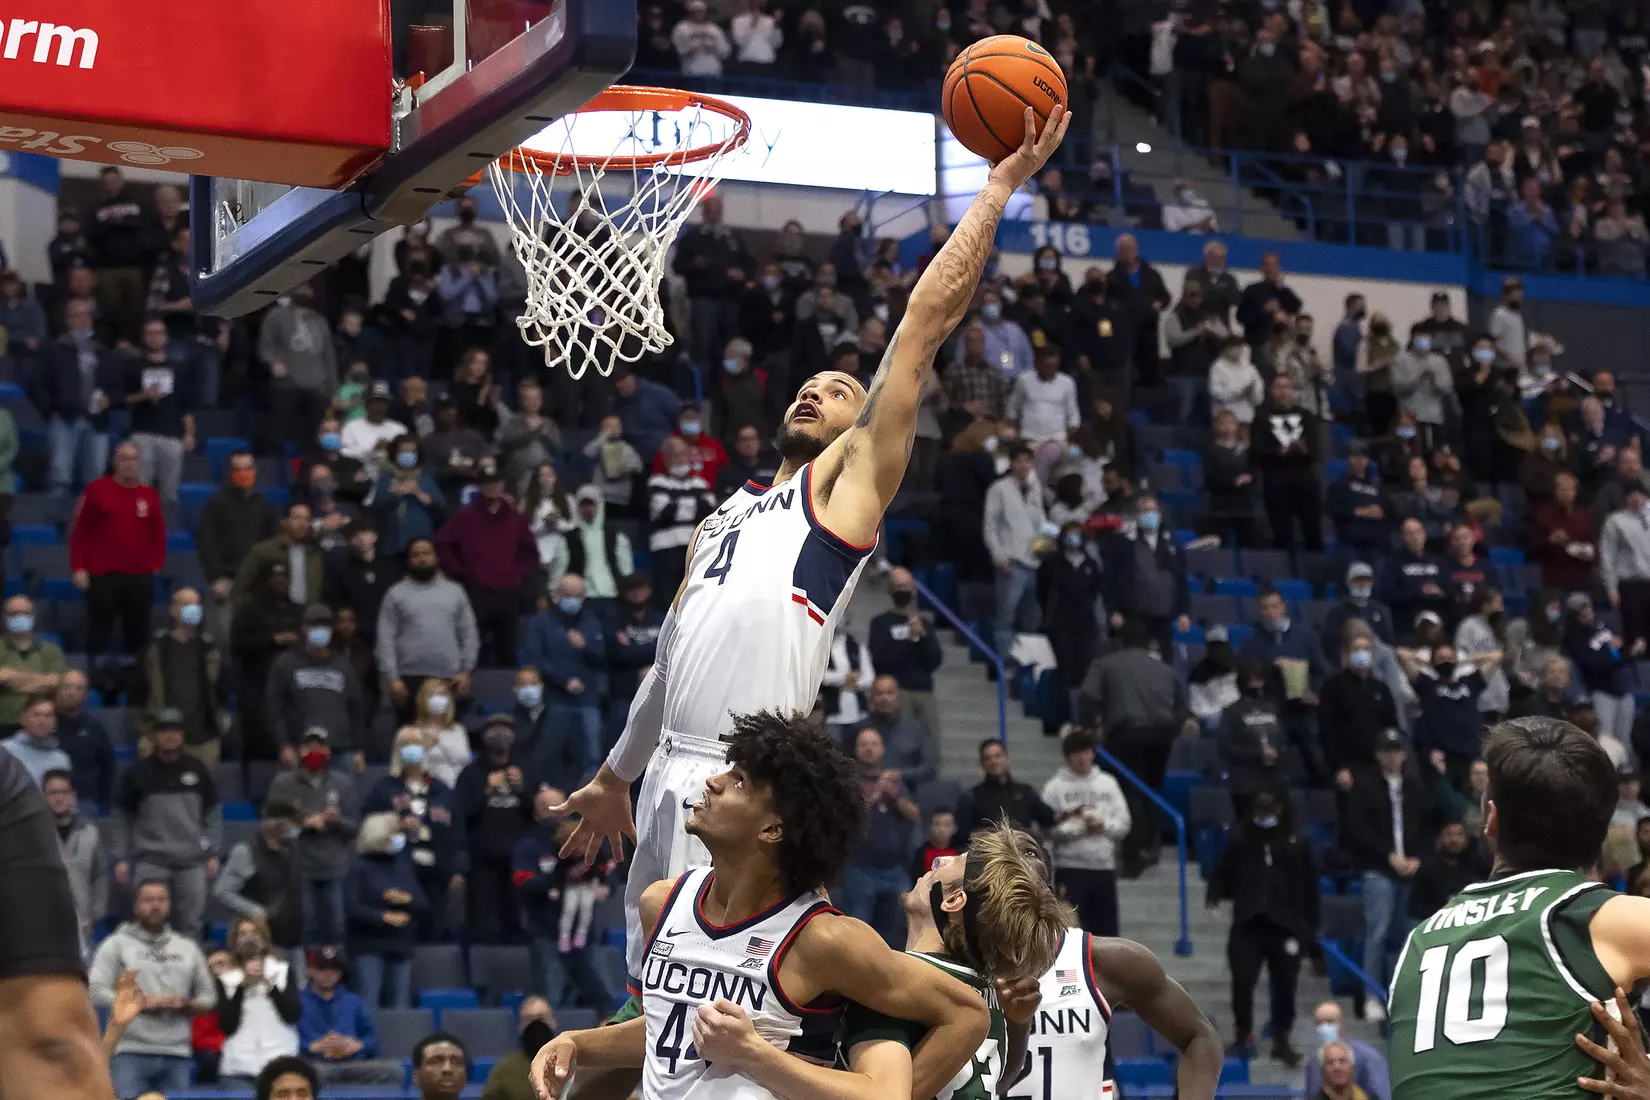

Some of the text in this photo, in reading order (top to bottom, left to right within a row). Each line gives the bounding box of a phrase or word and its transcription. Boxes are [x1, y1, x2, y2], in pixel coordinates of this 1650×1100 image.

[0, 18, 99, 69] rm
[1029, 222, 1091, 256] 116
[703, 530, 740, 586] 4
[1423, 887, 1549, 934] TINSLEY
[645, 957, 767, 1011] UCONN
[1414, 935, 1508, 1054] 10
[656, 1003, 712, 1074] 4
[1030, 1009, 1090, 1035] NN
